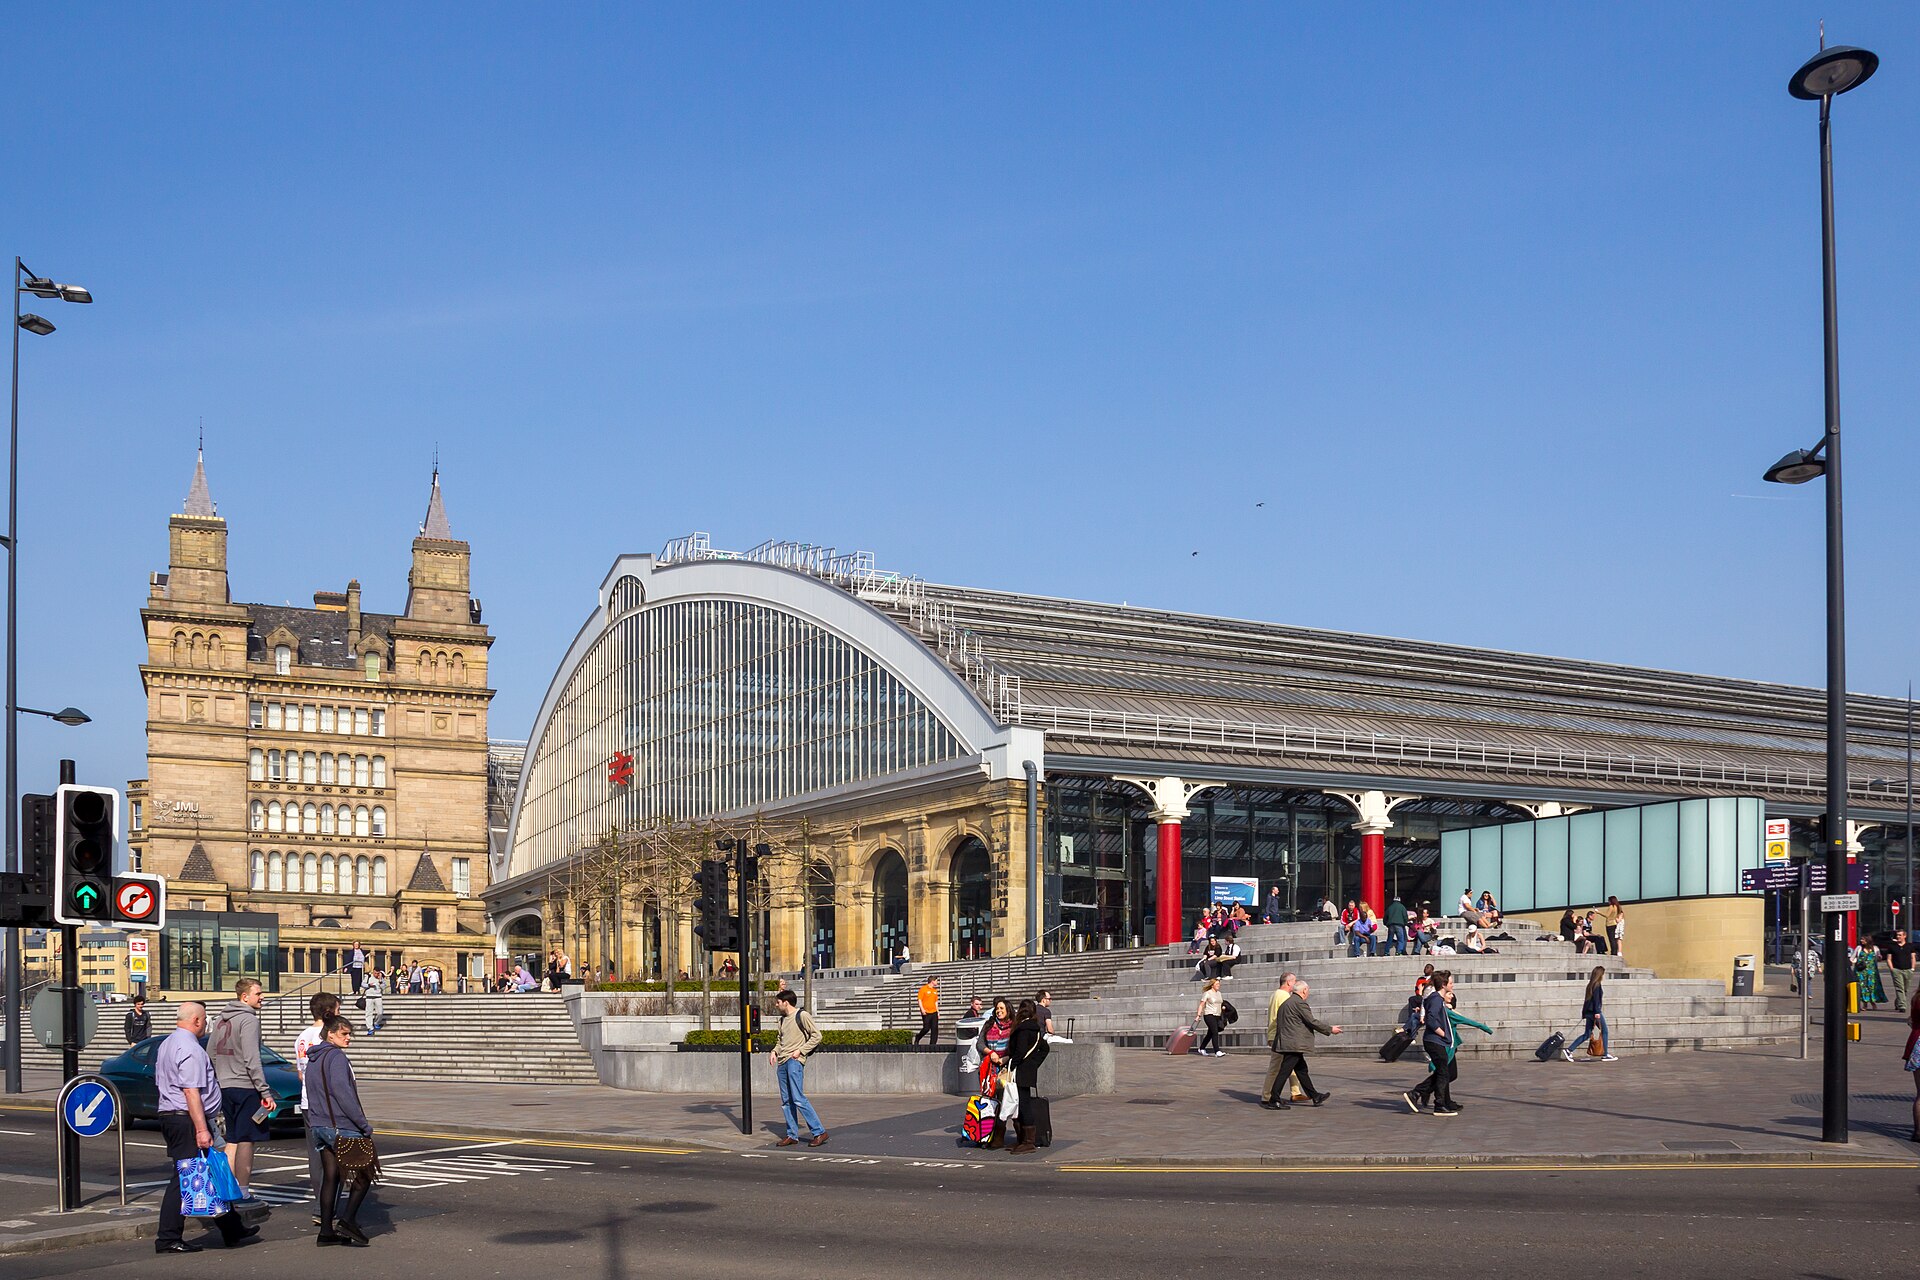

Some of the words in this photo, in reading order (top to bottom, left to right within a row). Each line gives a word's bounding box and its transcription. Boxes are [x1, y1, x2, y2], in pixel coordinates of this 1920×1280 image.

[173, 801, 199, 812] JMU
[216, 1019, 234, 1056] 2
[787, 1156, 882, 1165] RIGHT
[904, 1161, 985, 1169] LOOK
